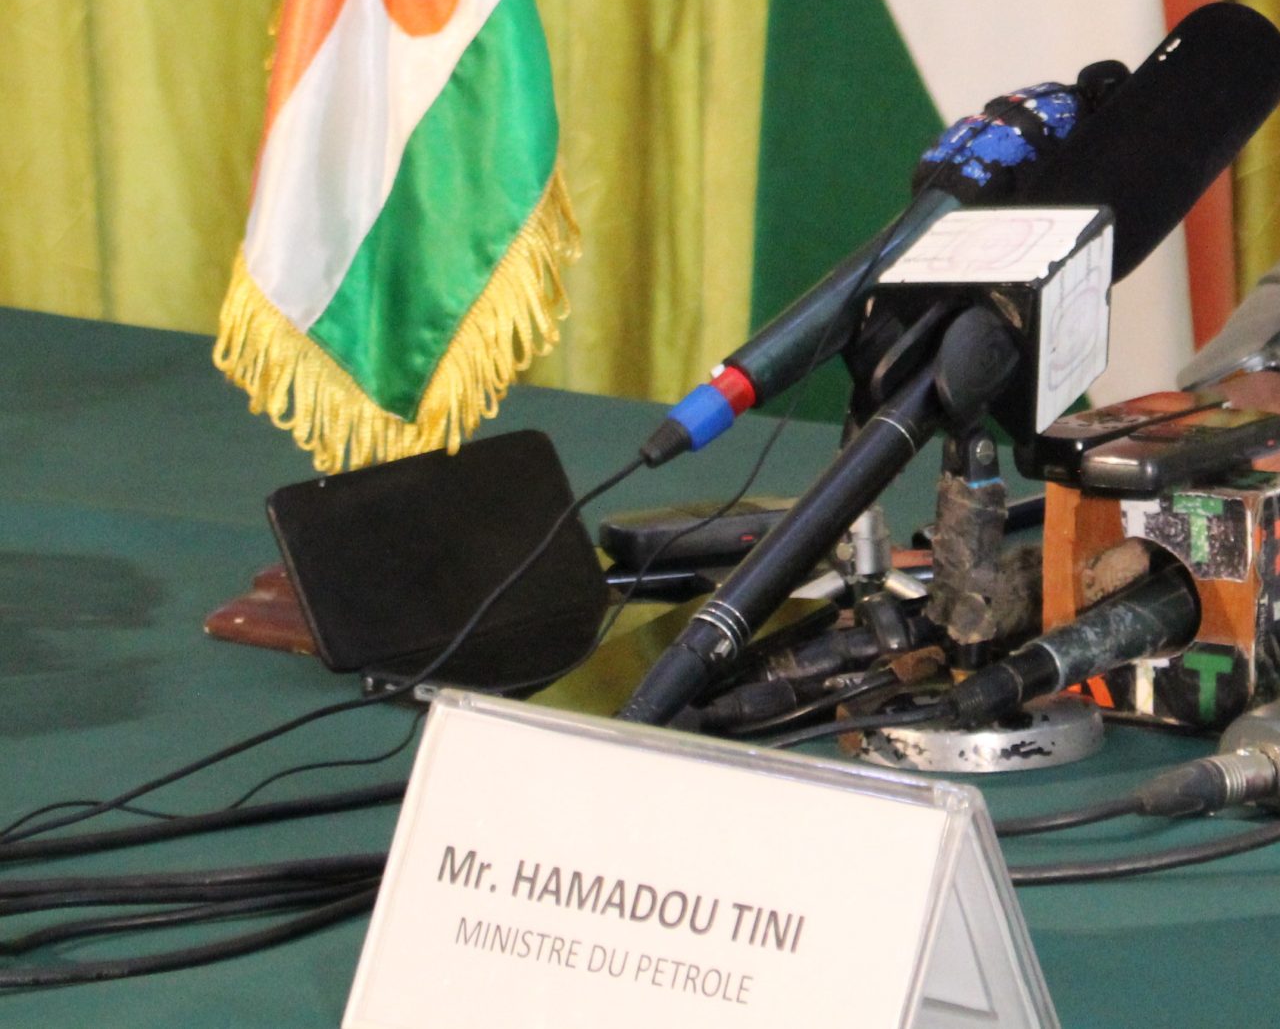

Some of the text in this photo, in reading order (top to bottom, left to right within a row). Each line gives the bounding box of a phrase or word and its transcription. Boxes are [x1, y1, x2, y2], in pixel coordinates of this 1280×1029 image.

[437, 845, 805, 954] Mr. HAMADOU TINI
[455, 916, 754, 1004] MINISTRE DU PETROLE
